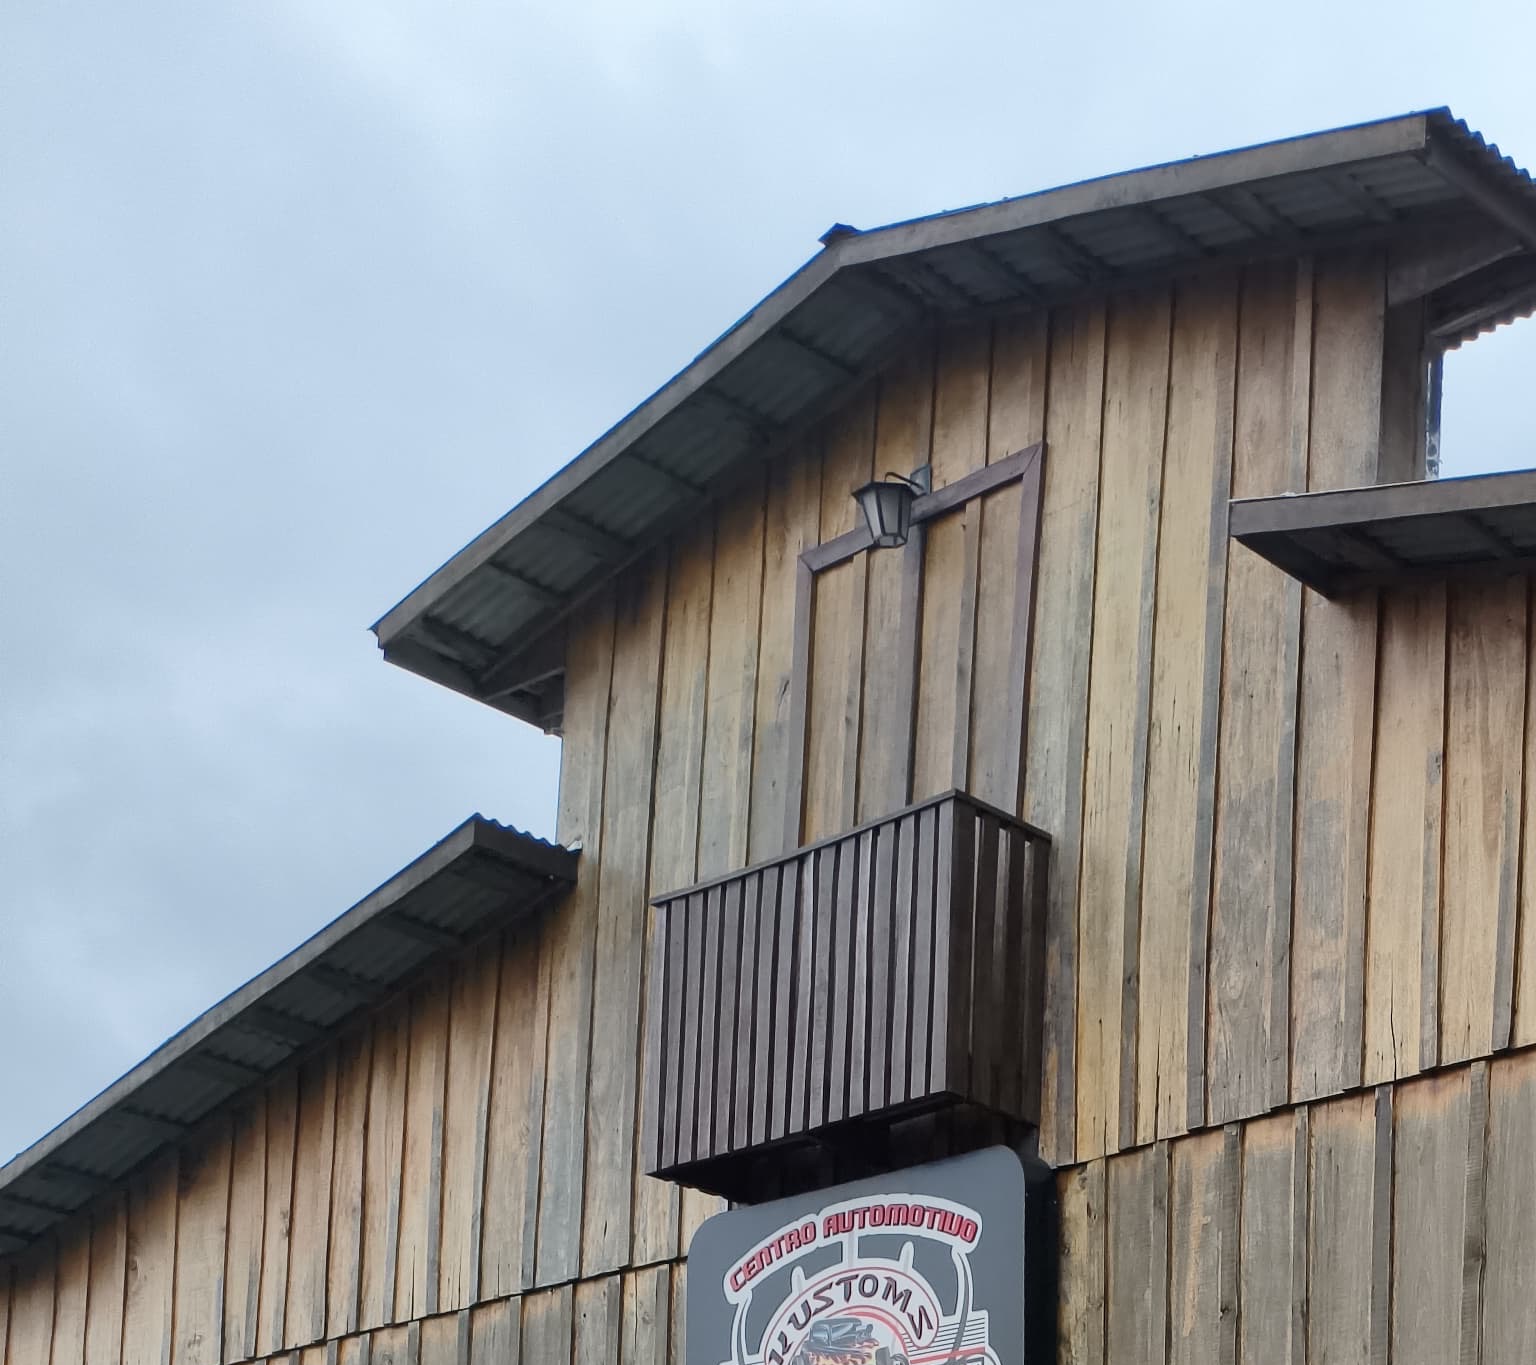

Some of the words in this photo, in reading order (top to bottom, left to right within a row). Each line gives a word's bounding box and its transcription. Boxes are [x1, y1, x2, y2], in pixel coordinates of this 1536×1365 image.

[729, 1221, 817, 1292] CENTRO
[823, 1203, 979, 1243] AUTOMOTIVO
[766, 1273, 934, 1365] KUSTOMS
